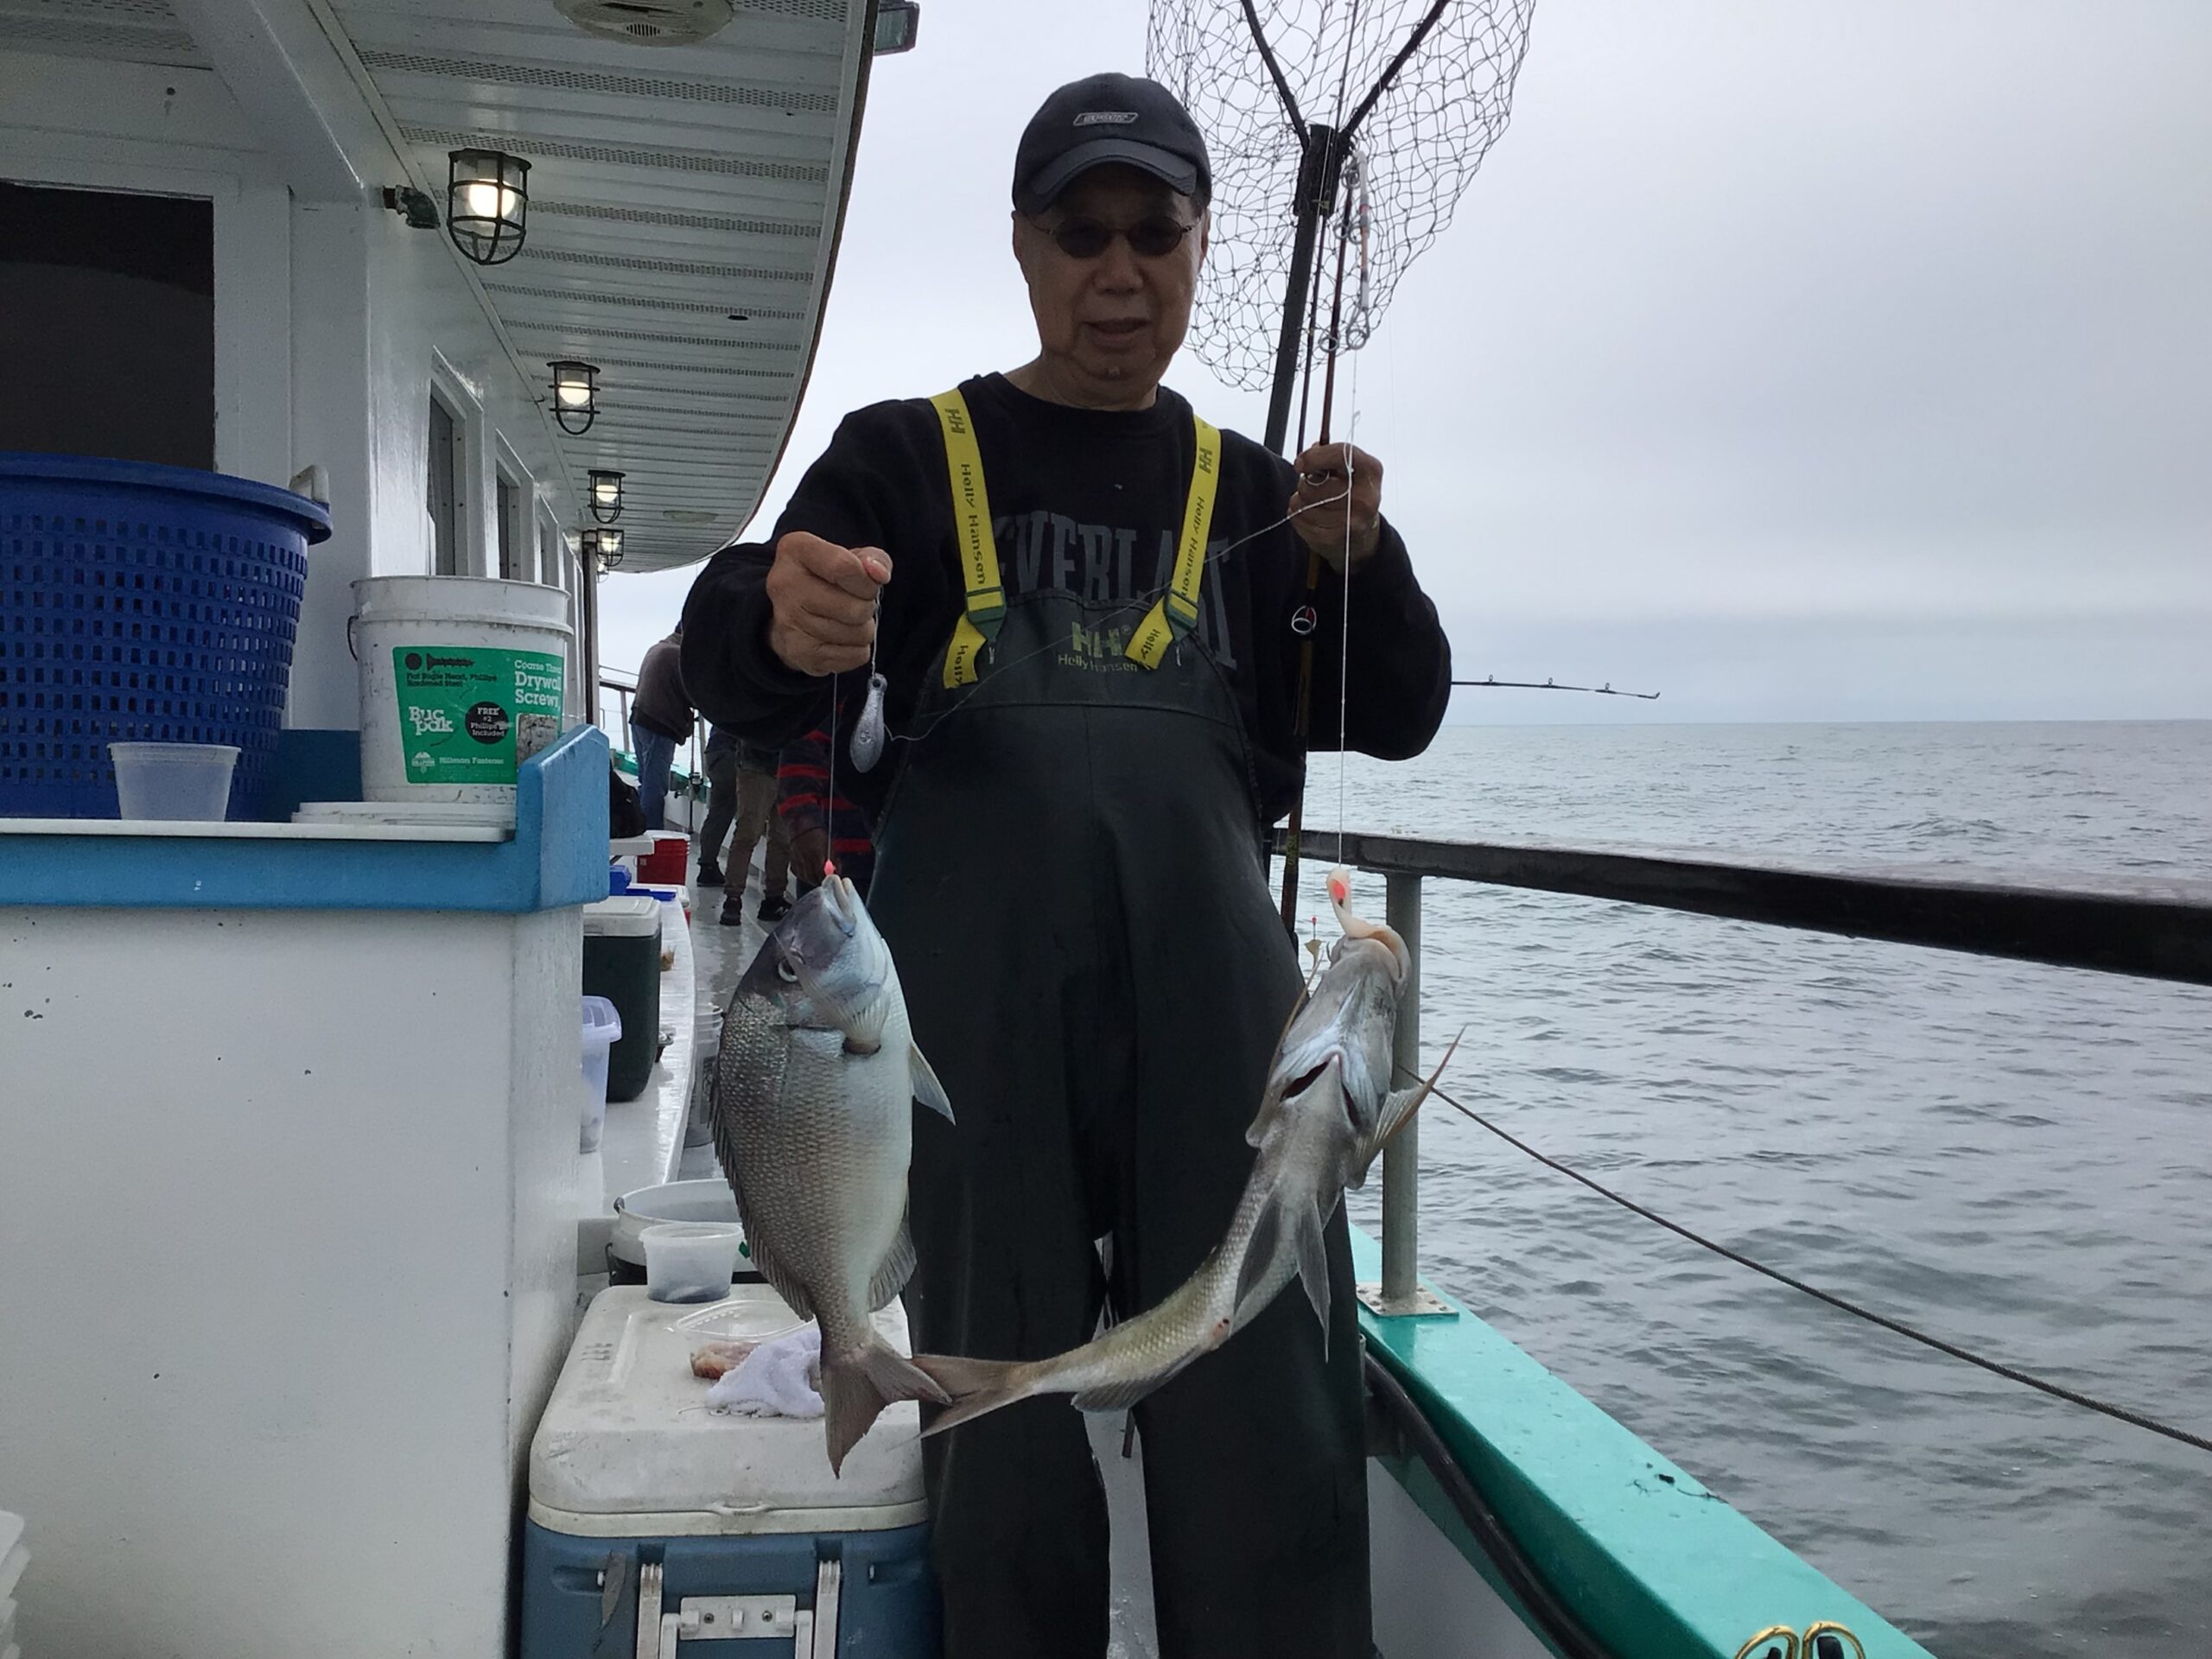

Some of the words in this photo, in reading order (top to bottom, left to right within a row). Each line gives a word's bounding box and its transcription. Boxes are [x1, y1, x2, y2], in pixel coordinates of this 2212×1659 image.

[961, 464, 976, 508] Helly
[969, 514, 986, 584] Hansen
[1193, 496, 1205, 534] Helly
[994, 510, 1237, 671] VERLAT
[1181, 537, 1198, 596] Hansen
[1058, 653, 1088, 670] Helly
[477, 707, 500, 715] FREE
